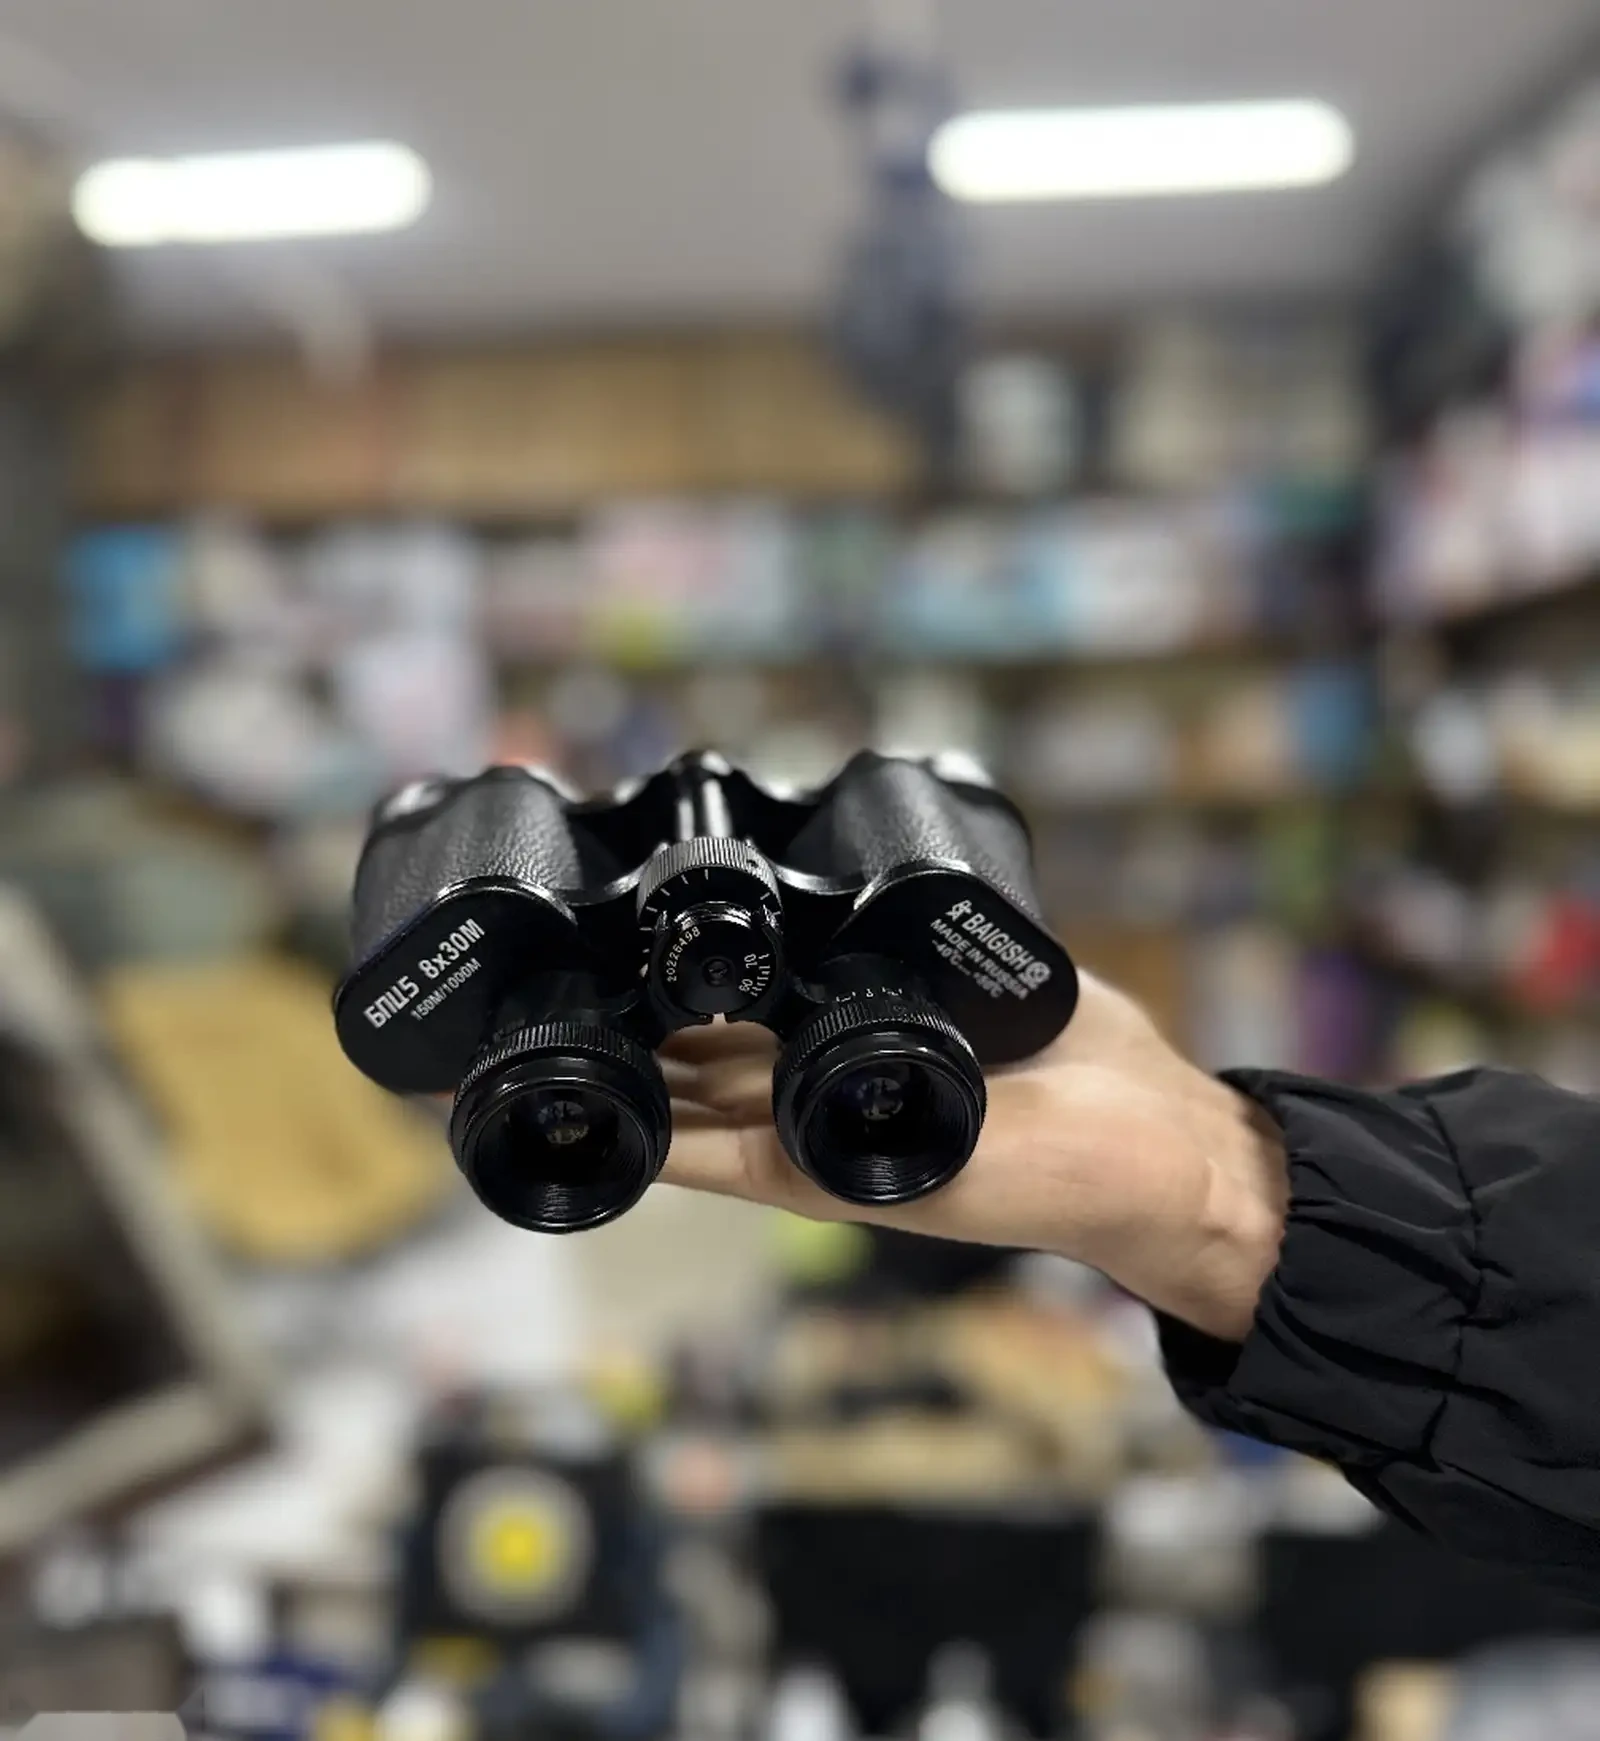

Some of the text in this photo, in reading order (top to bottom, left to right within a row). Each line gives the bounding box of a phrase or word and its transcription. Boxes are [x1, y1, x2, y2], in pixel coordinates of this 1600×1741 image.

[363, 918, 486, 1029] БПЦ5 8x30M
[930, 918, 973, 953] MADE
[965, 947, 986, 963] IN
[980, 958, 1029, 1000] RUSSIA
[962, 913, 1035, 971] BAIGISH
[410, 957, 482, 1021] 150M/1000M
